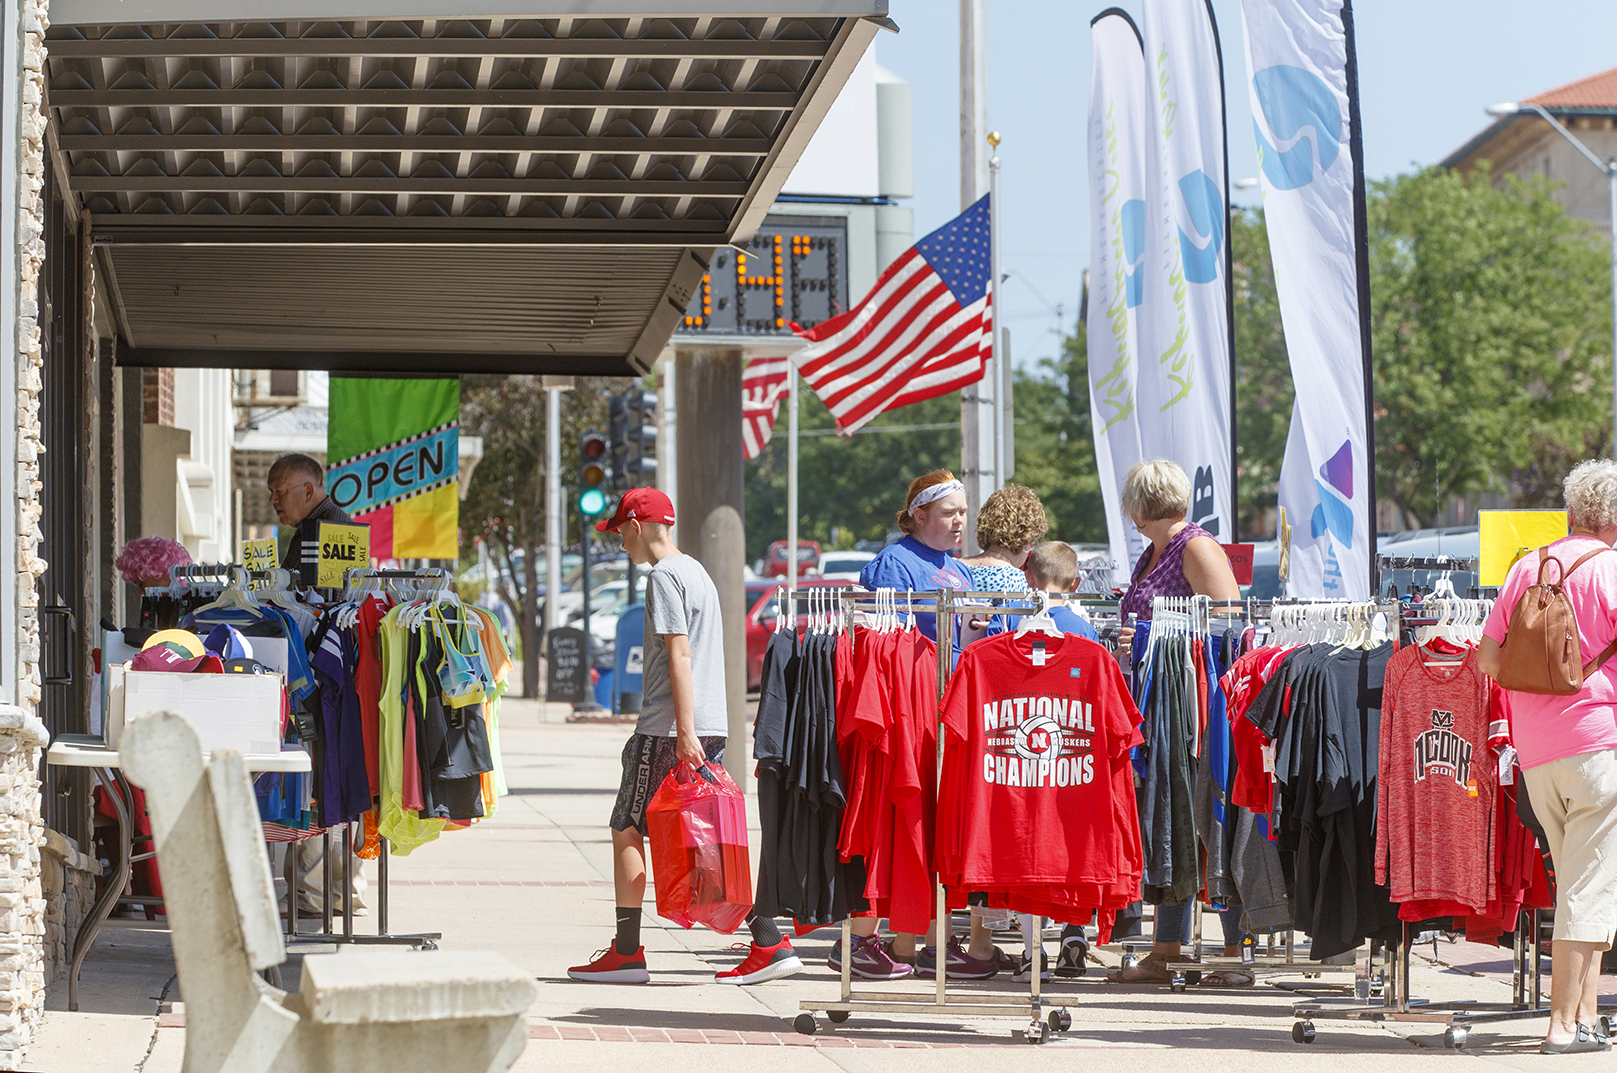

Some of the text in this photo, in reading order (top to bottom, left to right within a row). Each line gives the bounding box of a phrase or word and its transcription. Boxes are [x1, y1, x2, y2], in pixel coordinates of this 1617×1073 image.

[330, 440, 443, 508] OPEN
[243, 544, 274, 560] SALE
[322, 543, 356, 561] SALE
[983, 696, 1096, 733] NATIONAL
[632, 735, 654, 815] UNDER ARM
[983, 753, 1095, 788] CHAMPIONS
